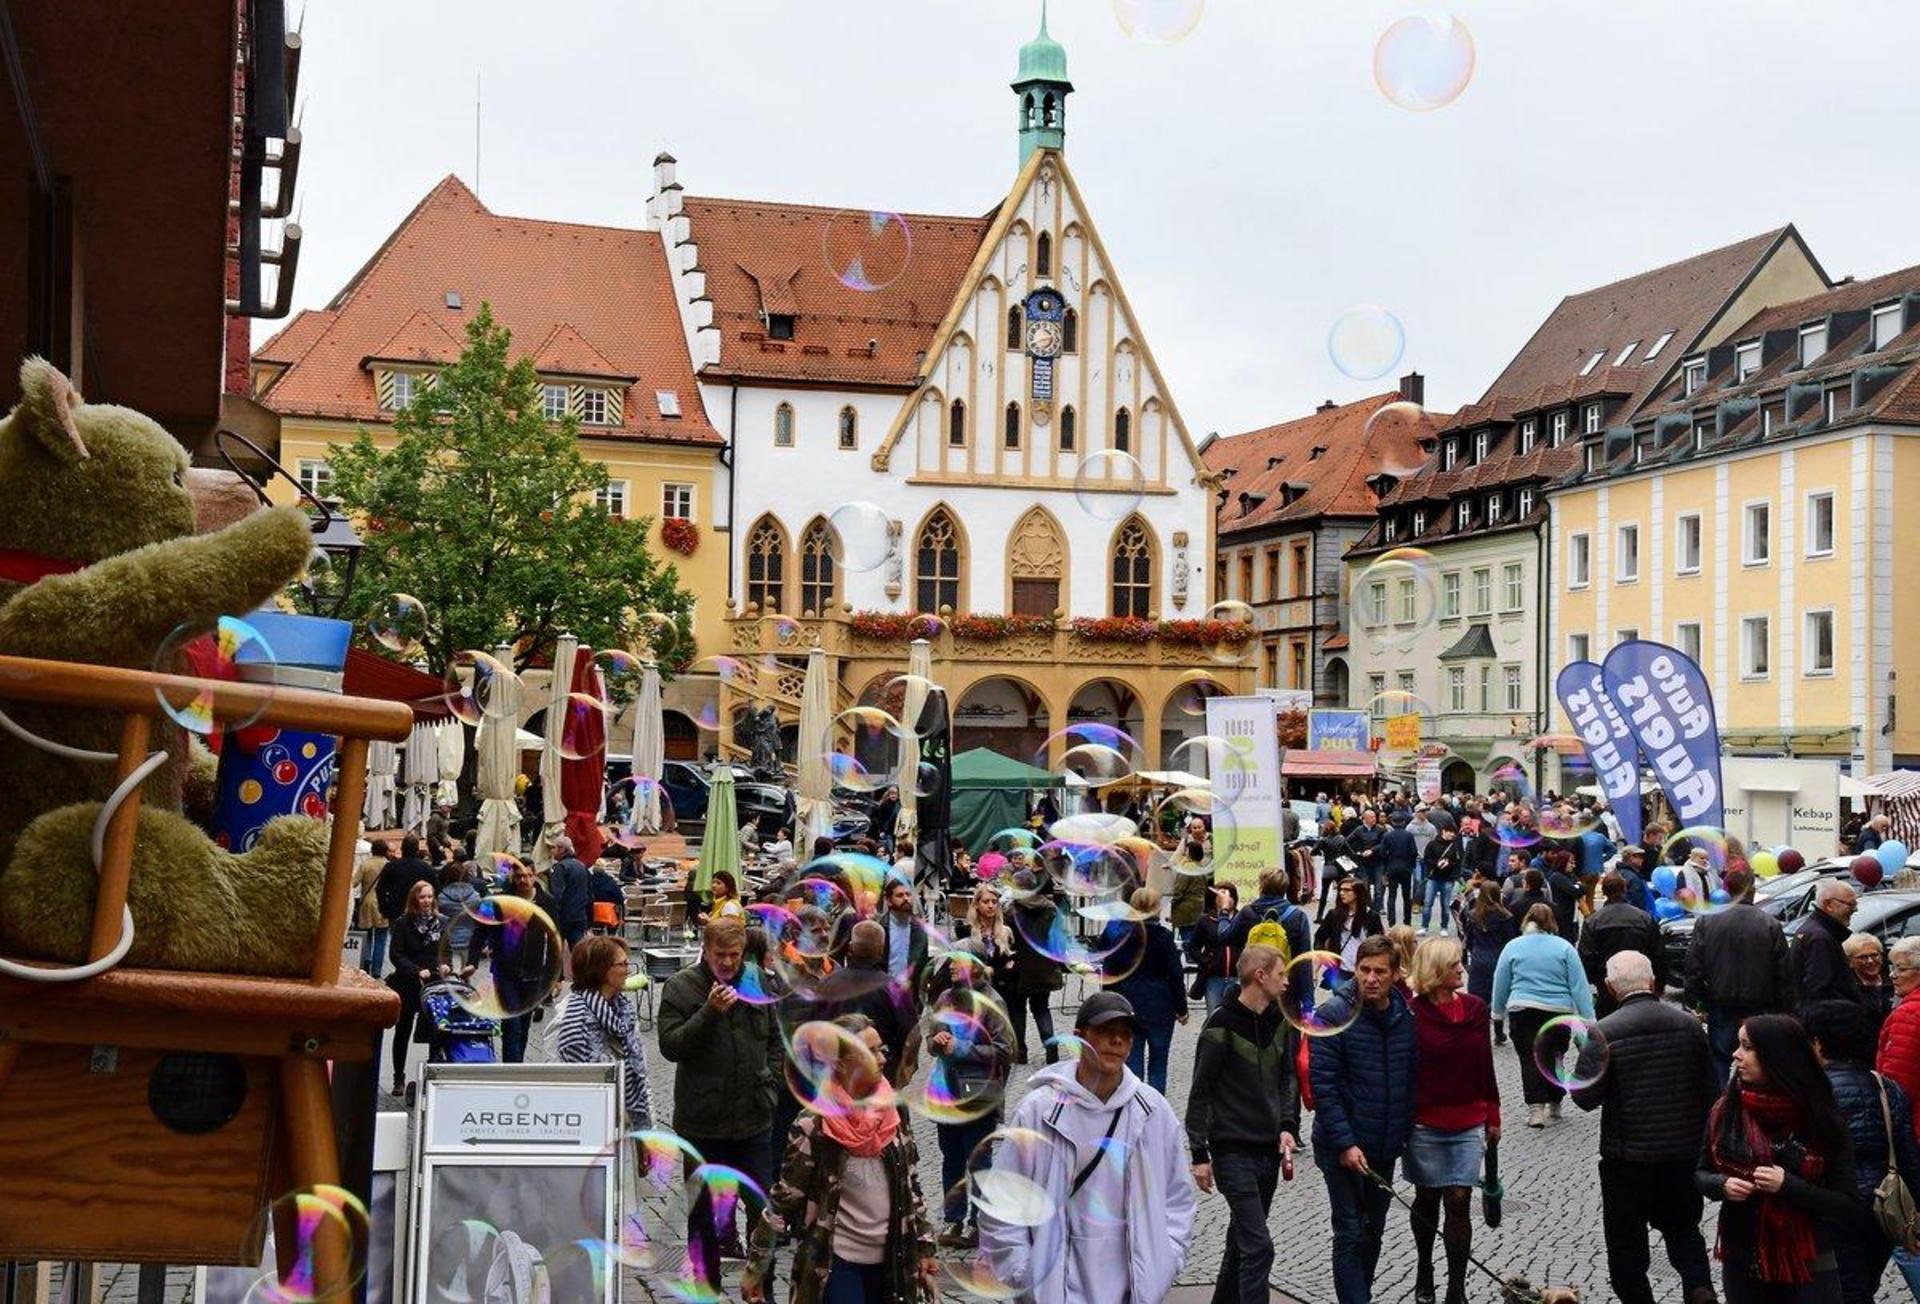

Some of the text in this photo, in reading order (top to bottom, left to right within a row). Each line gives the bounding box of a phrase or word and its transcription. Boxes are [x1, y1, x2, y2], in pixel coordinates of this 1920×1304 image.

[1724, 807, 1833, 821] ner Kebap
[461, 1112, 582, 1127] ARGENTO
